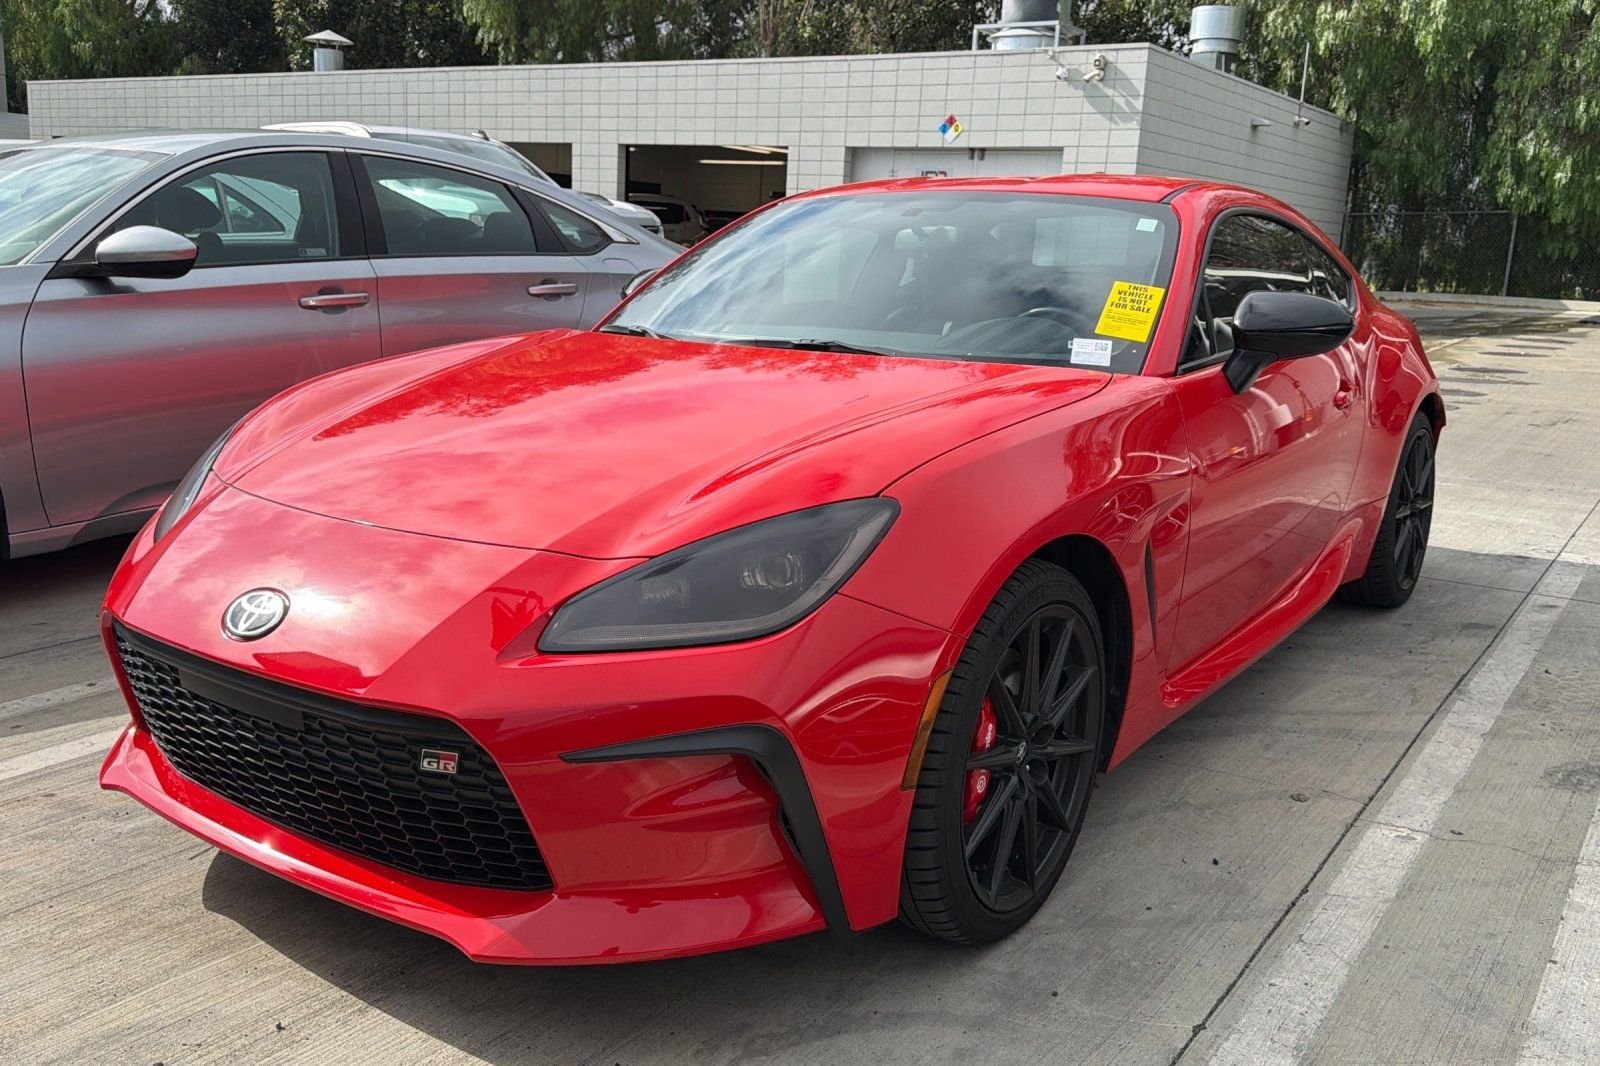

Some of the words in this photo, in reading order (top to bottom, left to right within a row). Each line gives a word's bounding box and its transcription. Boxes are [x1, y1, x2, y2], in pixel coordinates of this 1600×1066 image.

[1118, 289, 1155, 300] VEHICLE
[1128, 285, 1149, 293] THIS
[1110, 301, 1128, 310] FOR
[1129, 304, 1152, 314] SALE
[1129, 298, 1149, 306] NOT
[422, 757, 456, 772] GR
